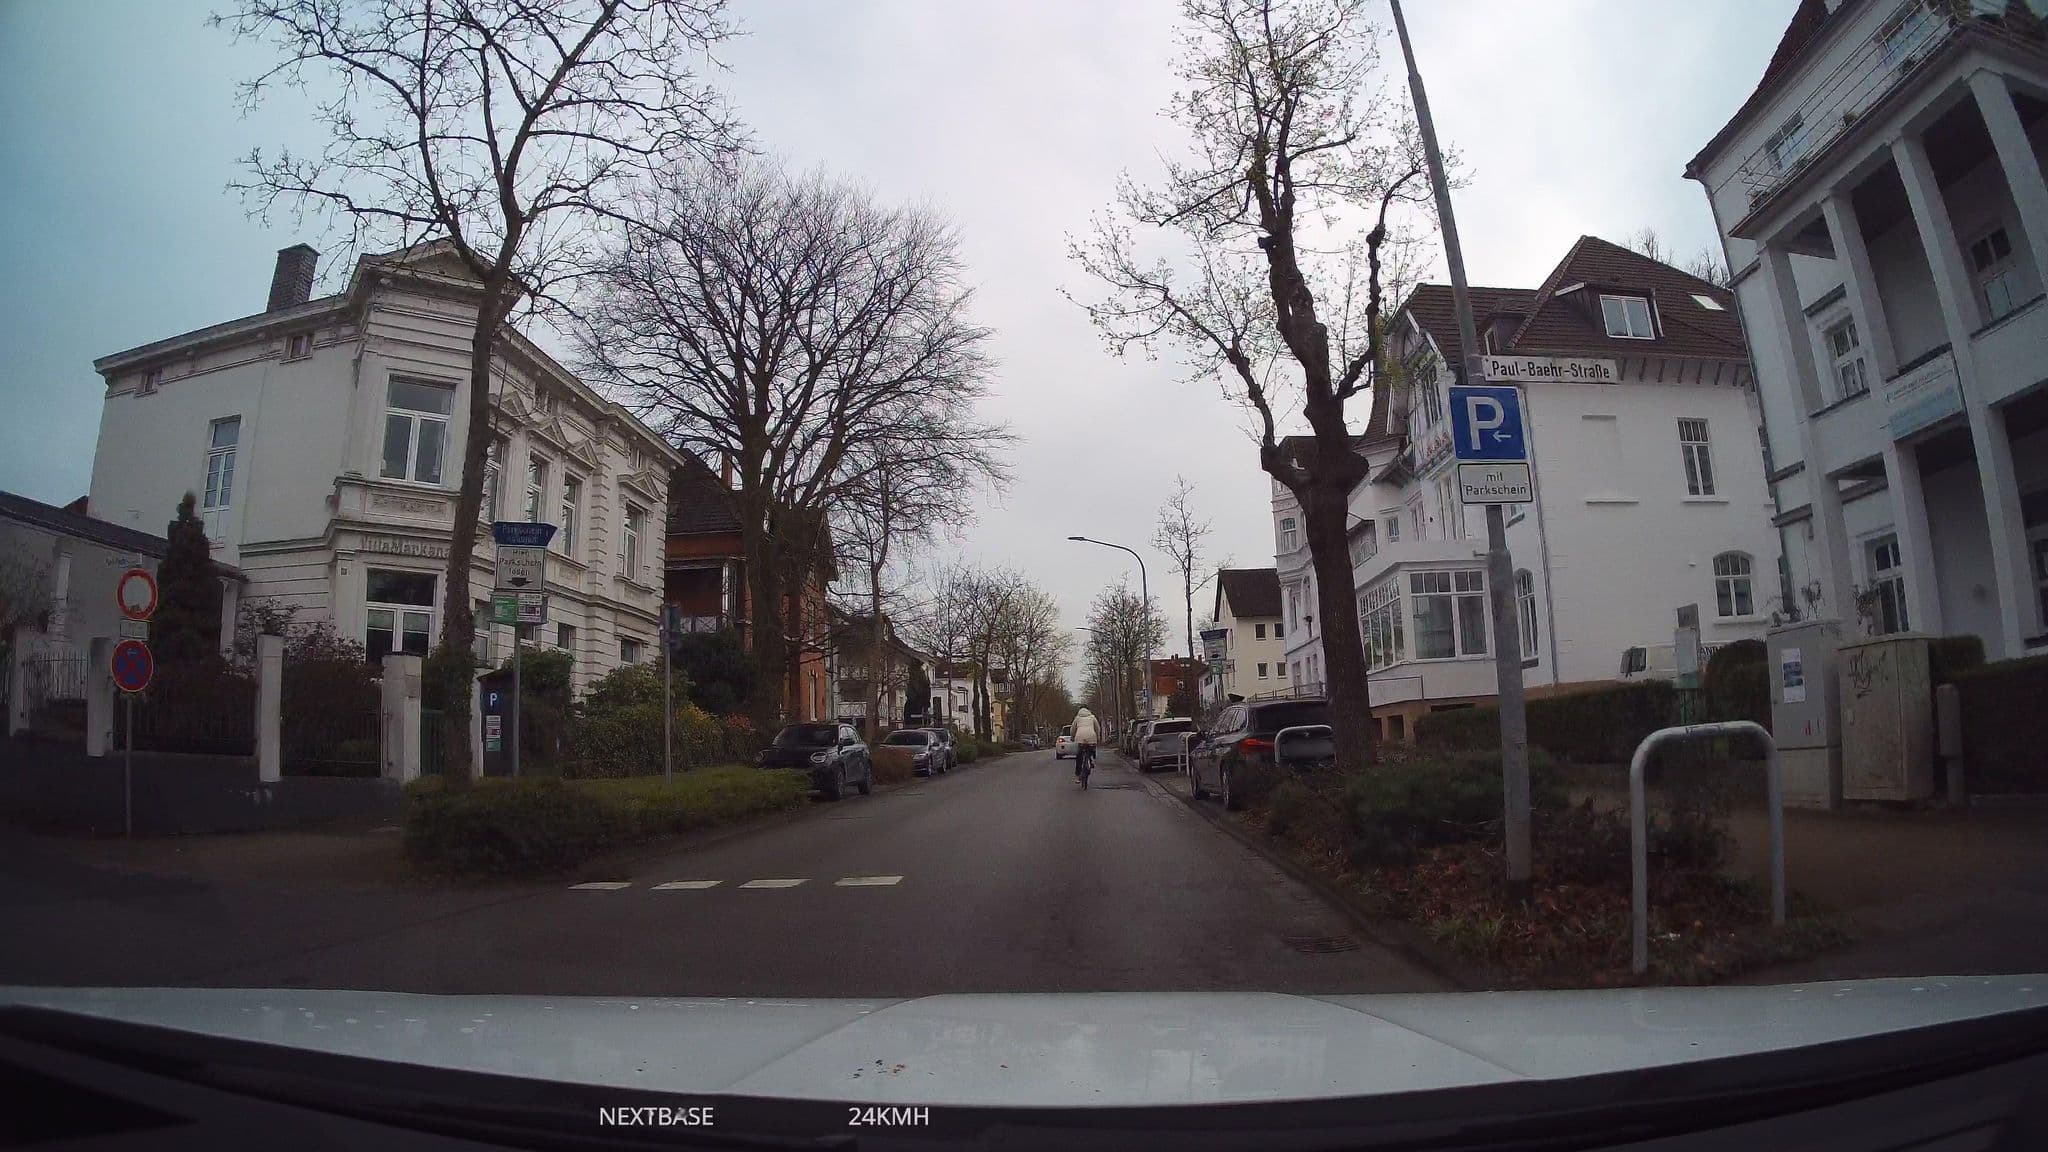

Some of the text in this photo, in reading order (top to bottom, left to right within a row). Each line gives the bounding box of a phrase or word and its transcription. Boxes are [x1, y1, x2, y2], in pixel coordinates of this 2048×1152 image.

[1491, 360, 1610, 379] Paul-Baehr-Straße
[1466, 396, 1505, 451] P
[1486, 471, 1503, 482] mit
[1465, 484, 1527, 496] Parkschein
[490, 692, 498, 706] P
